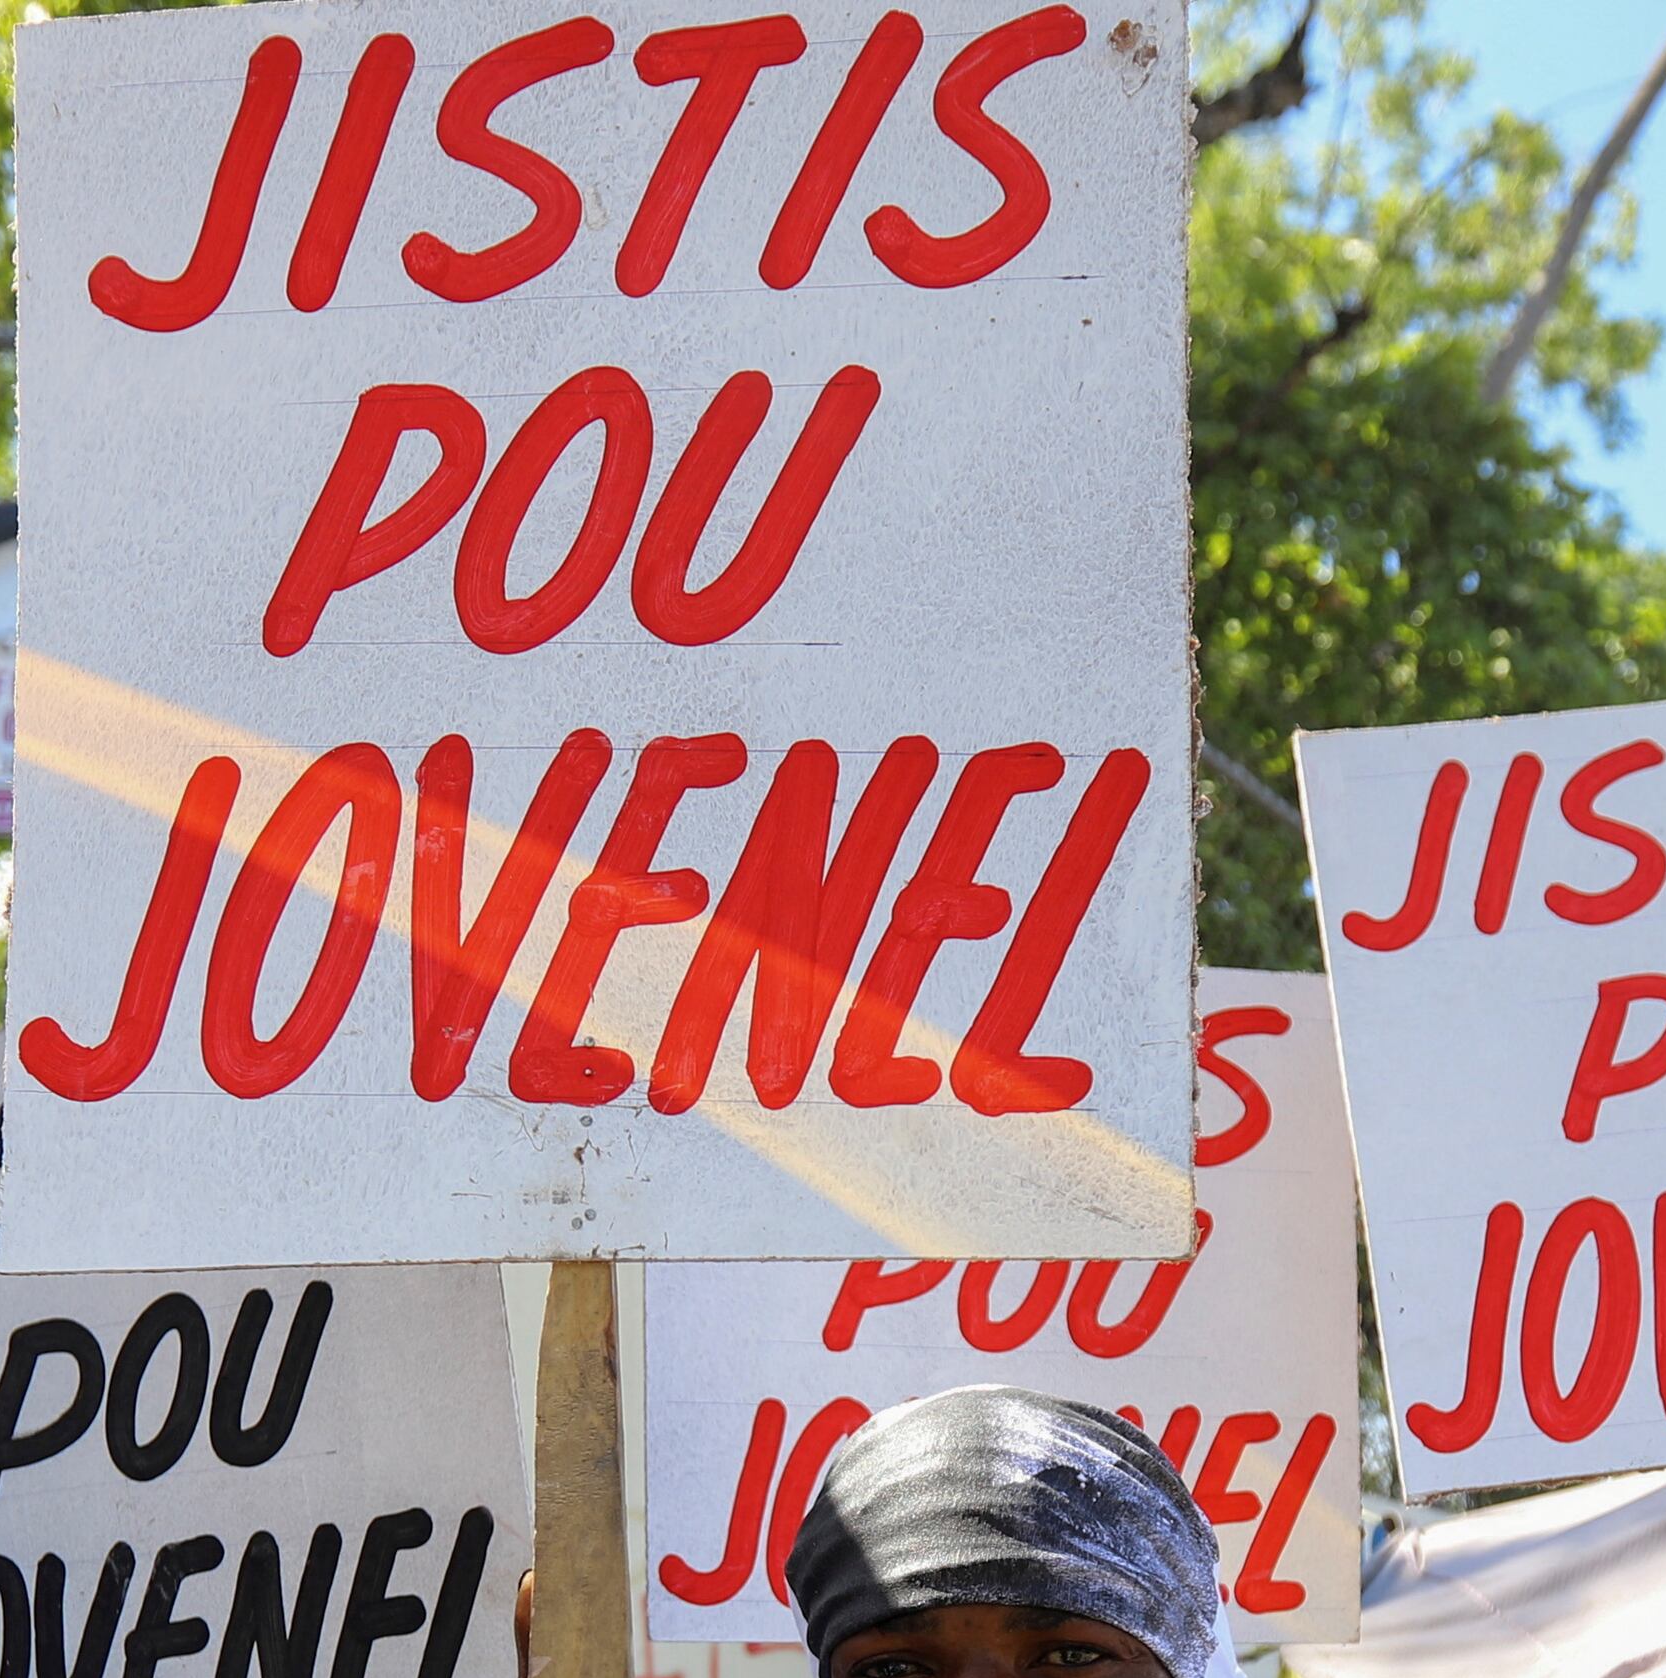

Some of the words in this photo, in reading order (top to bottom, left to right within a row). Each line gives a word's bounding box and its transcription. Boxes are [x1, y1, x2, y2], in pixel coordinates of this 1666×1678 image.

[88, 5, 1087, 332] JISTIS
[263, 365, 881, 657] POU
[18, 727, 1151, 1116] JOVENEL
